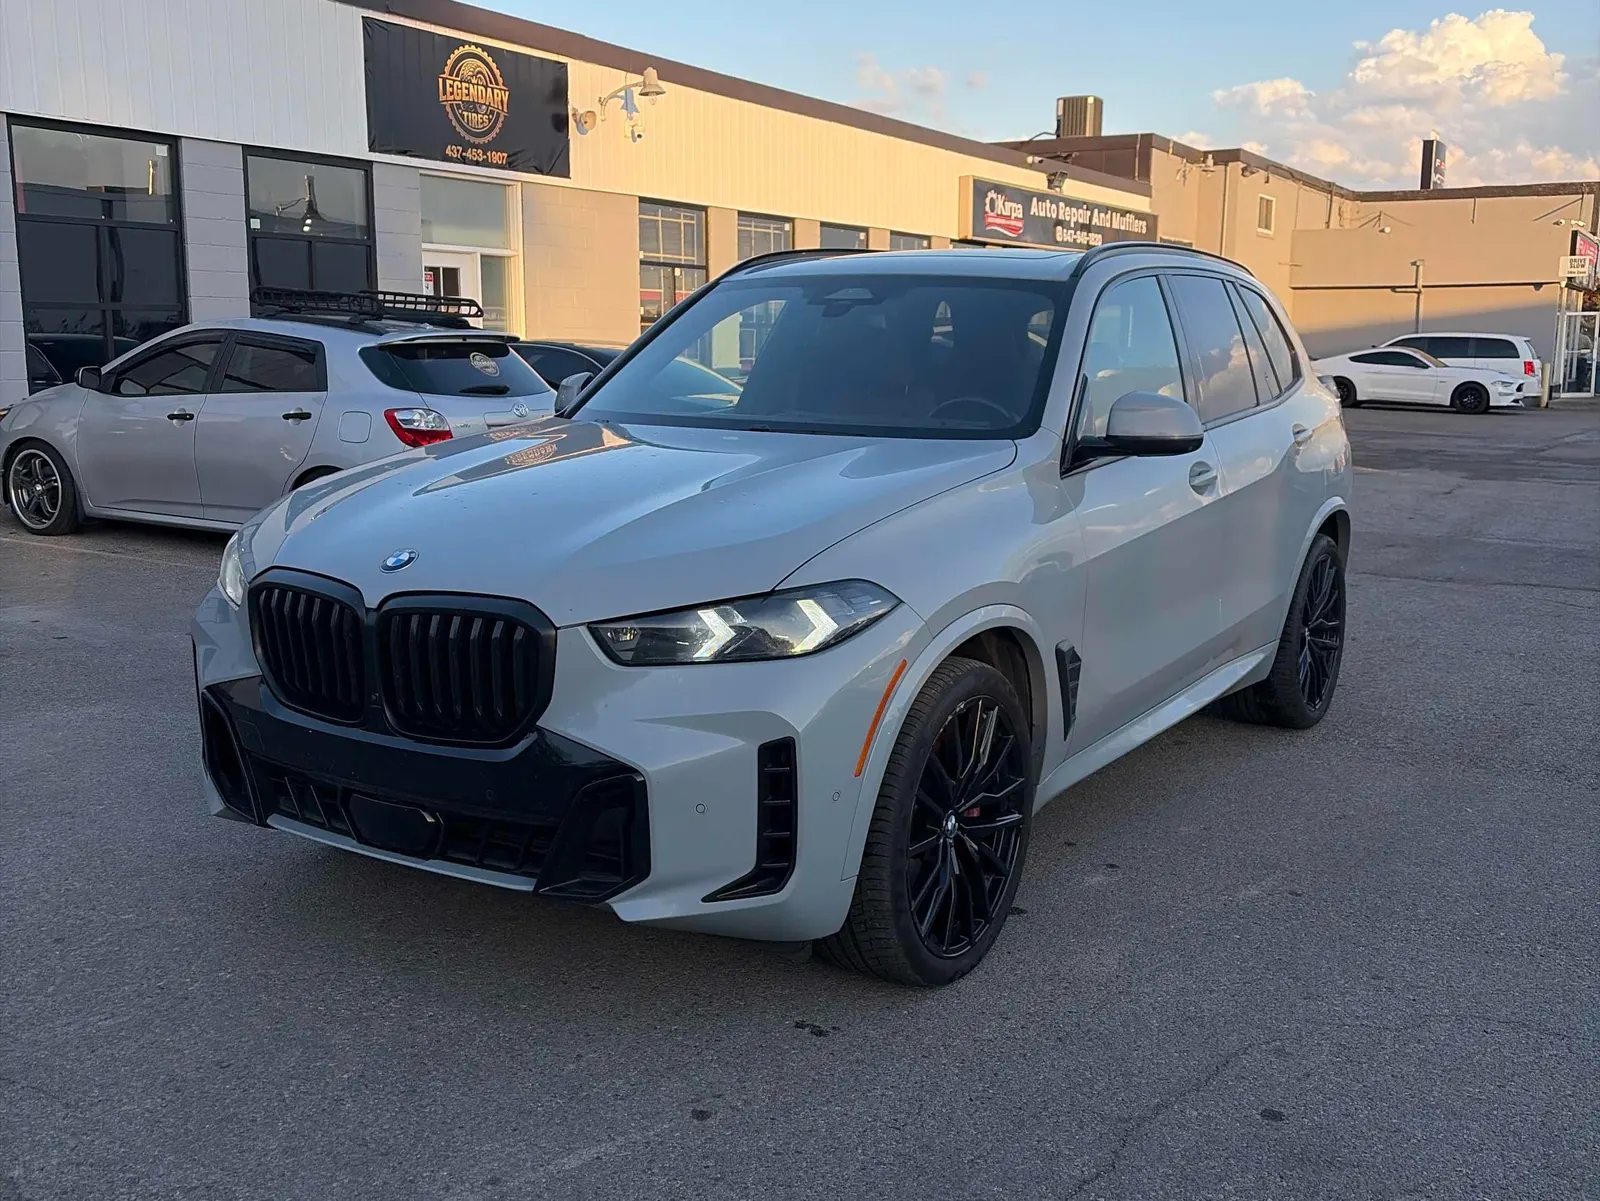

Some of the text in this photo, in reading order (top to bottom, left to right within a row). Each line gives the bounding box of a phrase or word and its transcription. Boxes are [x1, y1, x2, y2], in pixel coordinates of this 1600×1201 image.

[438, 77, 510, 114] LEGENDARY
[463, 111, 490, 128] TIRES
[445, 144, 508, 165] 437-453-1907
[1030, 196, 1147, 235] Auto Repair And Mufflers
